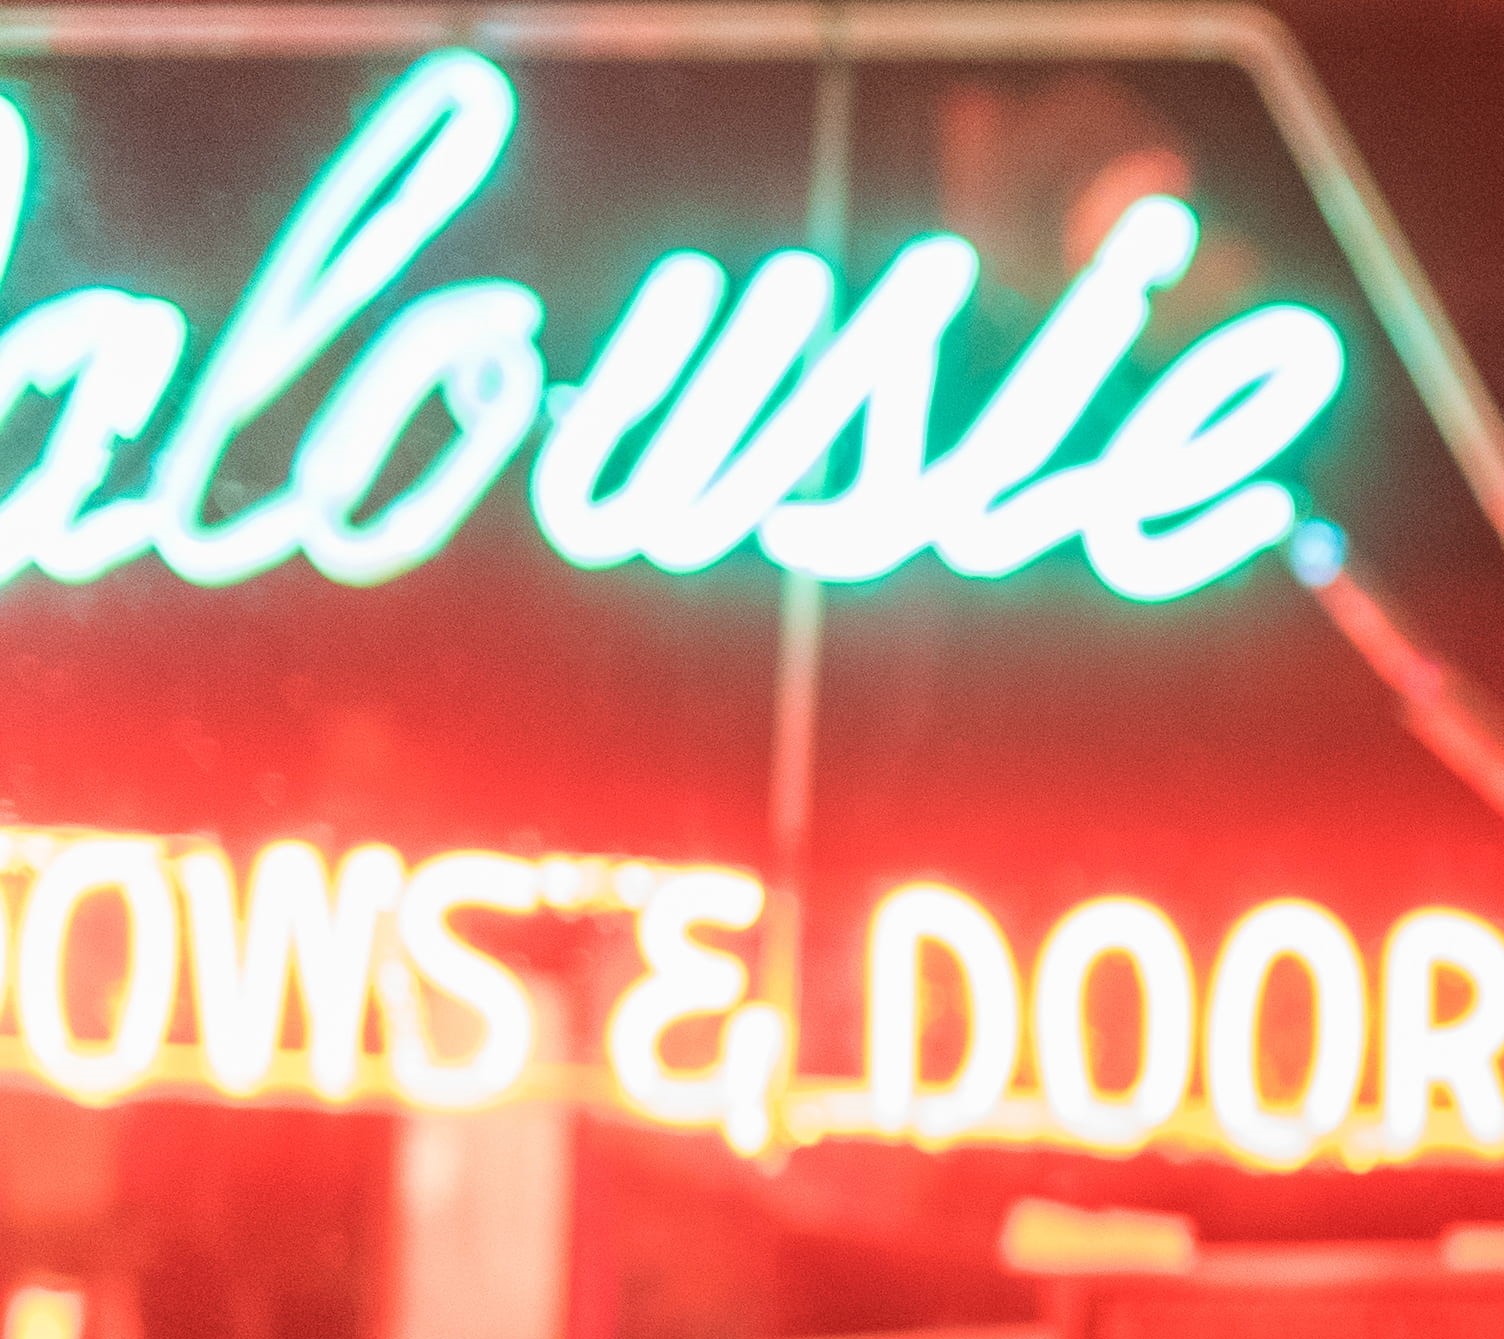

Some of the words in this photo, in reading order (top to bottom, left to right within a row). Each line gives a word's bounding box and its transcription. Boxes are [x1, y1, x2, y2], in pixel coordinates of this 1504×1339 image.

[0, 46, 1348, 602] alousie
[0, 834, 538, 1114] OWS
[606, 862, 786, 1158] &
